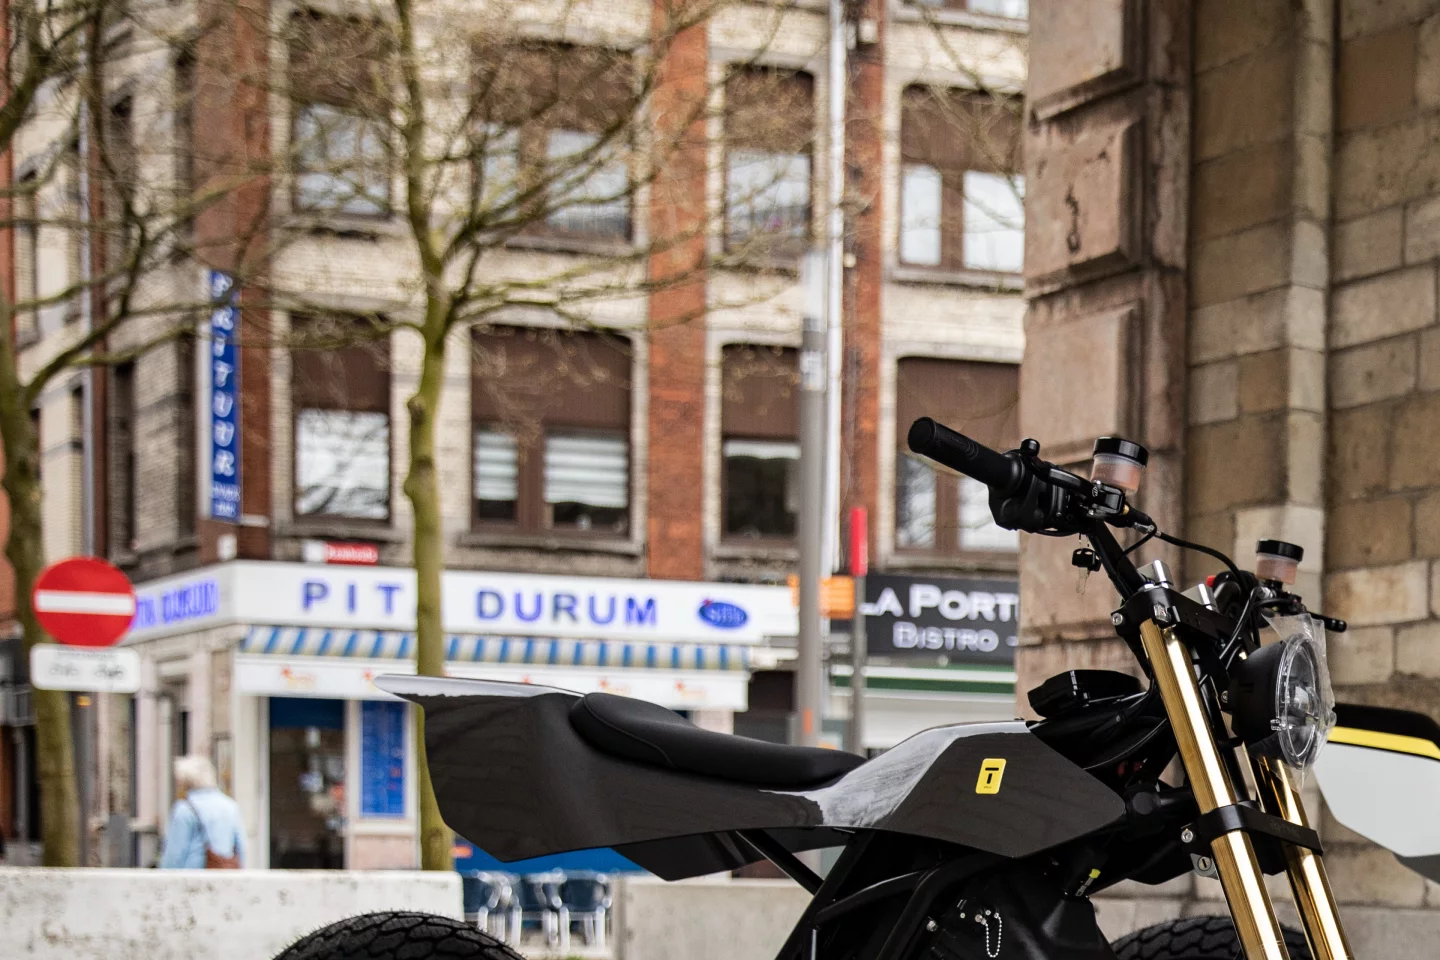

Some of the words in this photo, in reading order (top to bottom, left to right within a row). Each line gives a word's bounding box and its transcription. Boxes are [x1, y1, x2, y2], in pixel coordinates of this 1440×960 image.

[303, 581, 403, 614] PIT
[476, 588, 657, 626] DURUM
[908, 583, 1018, 622] PORT
[892, 620, 999, 652] BISTRO
